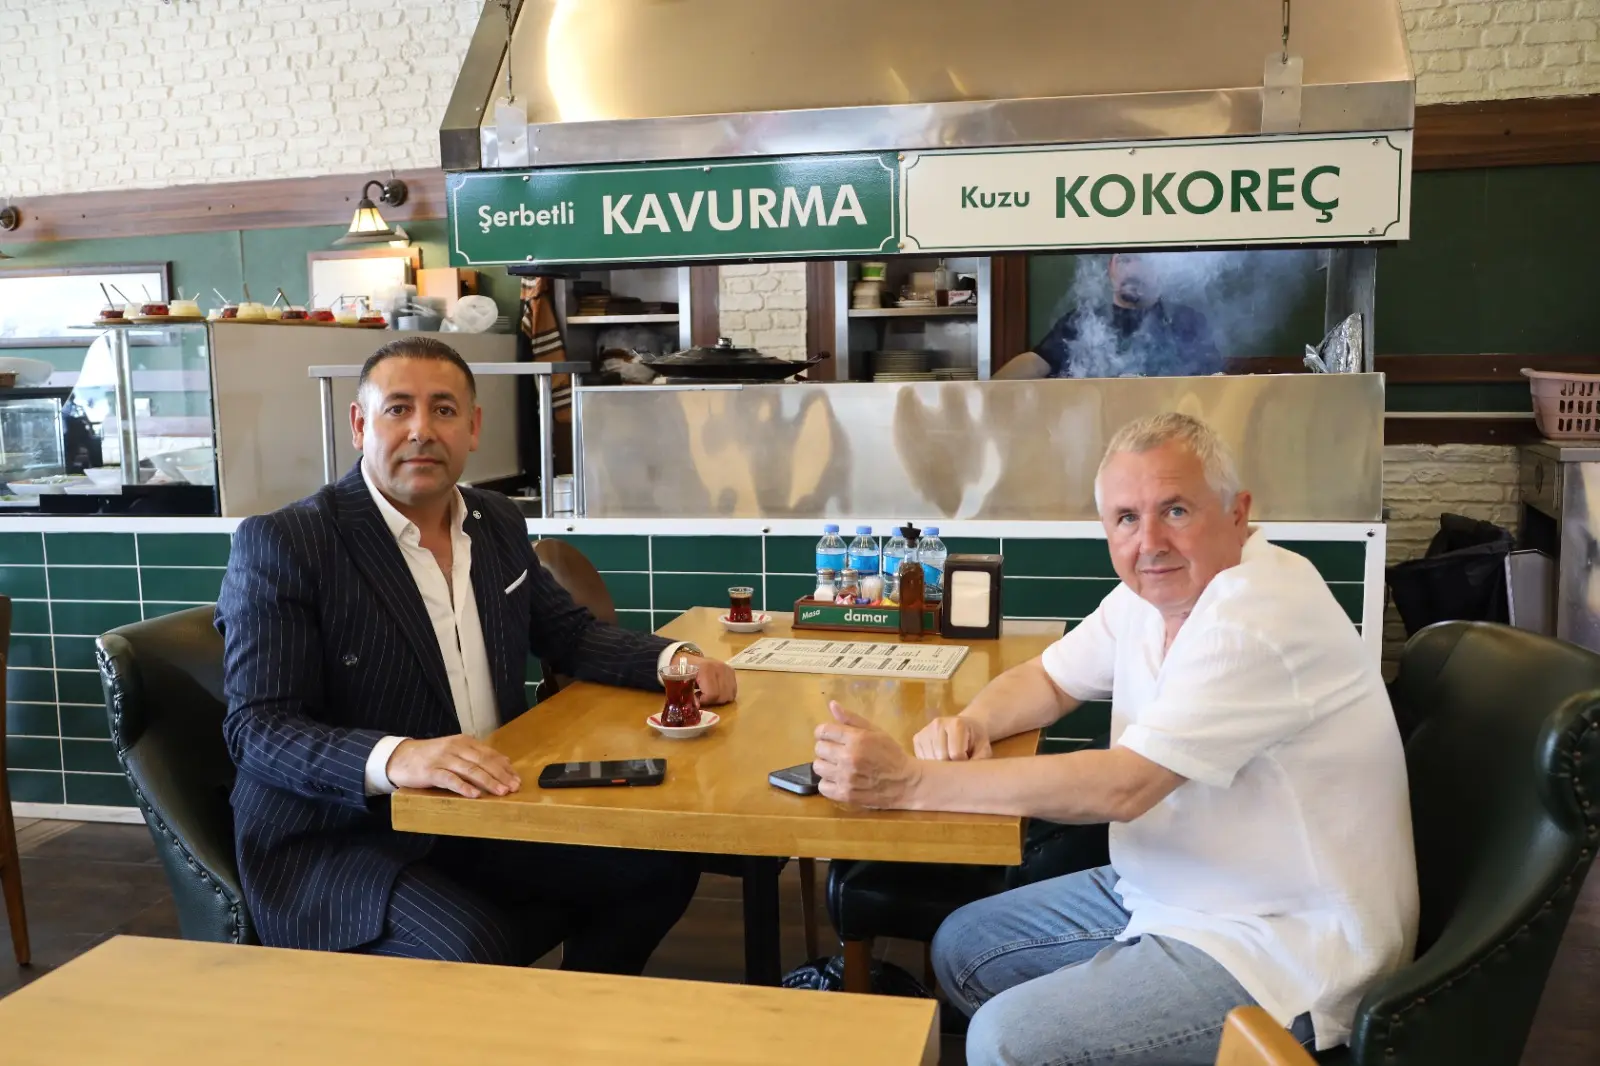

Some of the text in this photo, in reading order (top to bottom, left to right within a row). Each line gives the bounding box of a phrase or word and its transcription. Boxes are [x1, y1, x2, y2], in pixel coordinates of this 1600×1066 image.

[478, 184, 868, 235] Şerbetli KAVURMA
[961, 165, 1341, 223] Kuzu KOKOREÇ
[801, 609, 821, 621] Masa
[844, 608, 889, 624] damar
